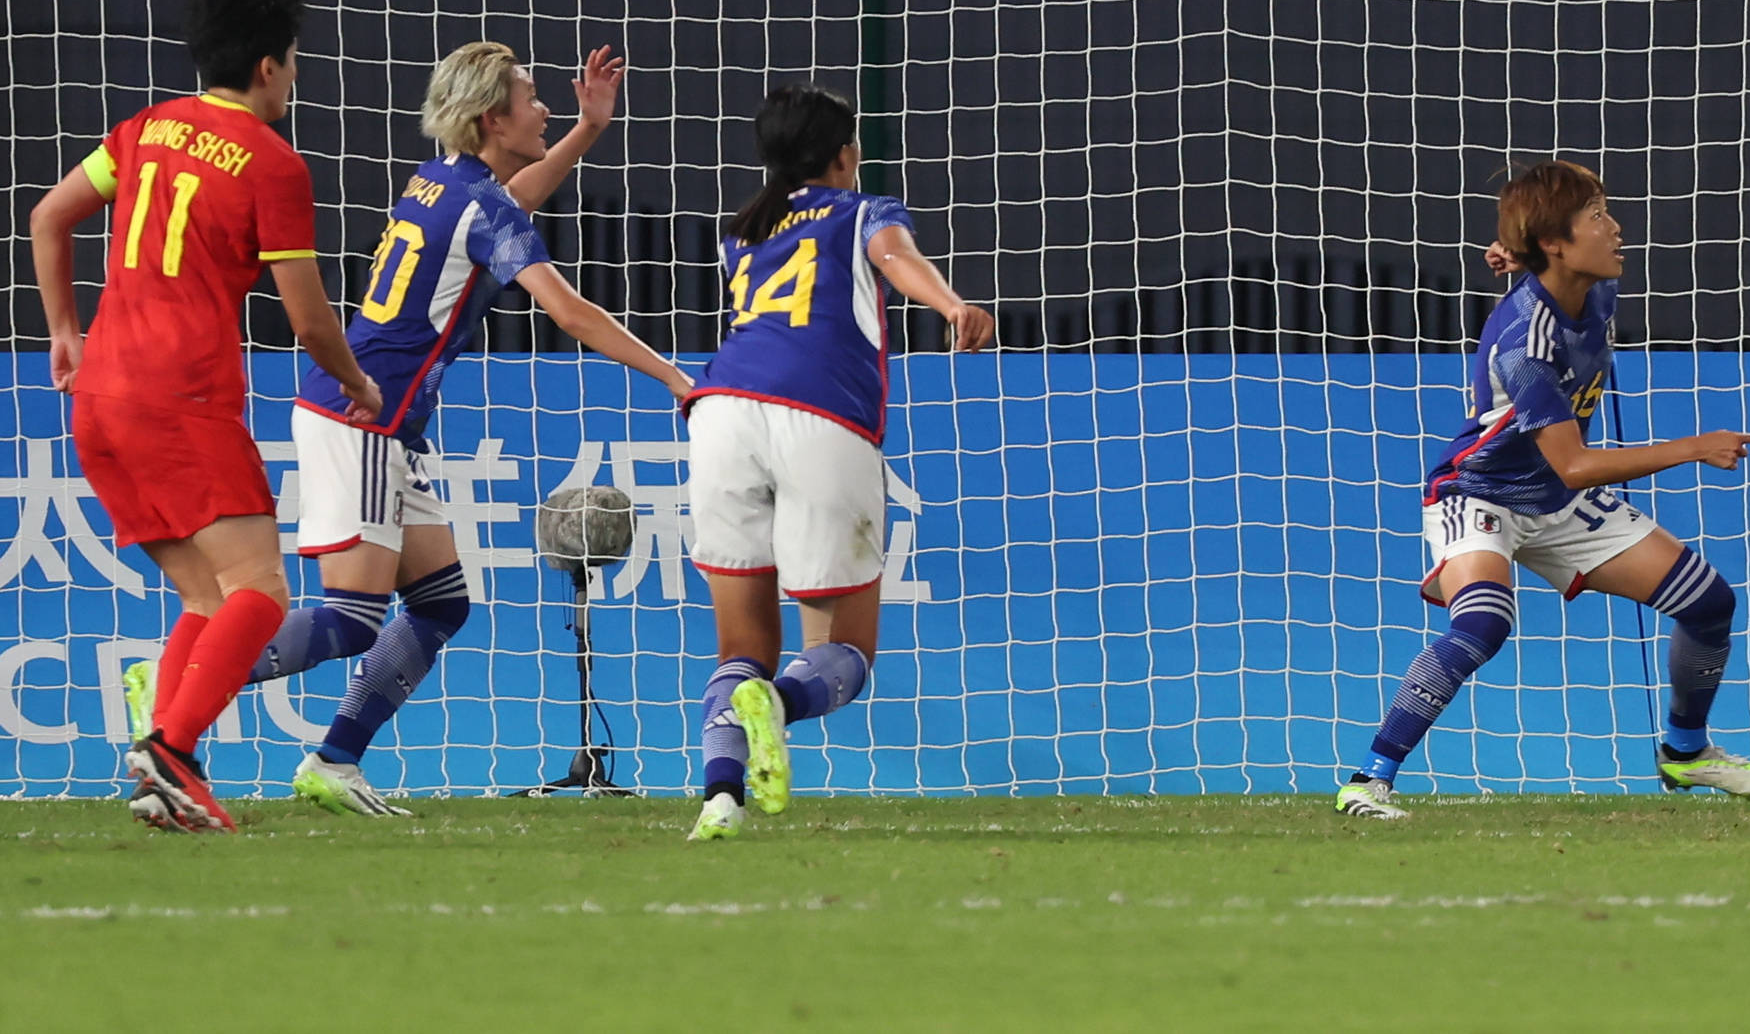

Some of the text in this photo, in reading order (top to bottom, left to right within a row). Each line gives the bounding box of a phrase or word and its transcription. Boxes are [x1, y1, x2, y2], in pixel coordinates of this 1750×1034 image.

[138, 118, 253, 178] WANG SHSH
[124, 161, 201, 278] 11
